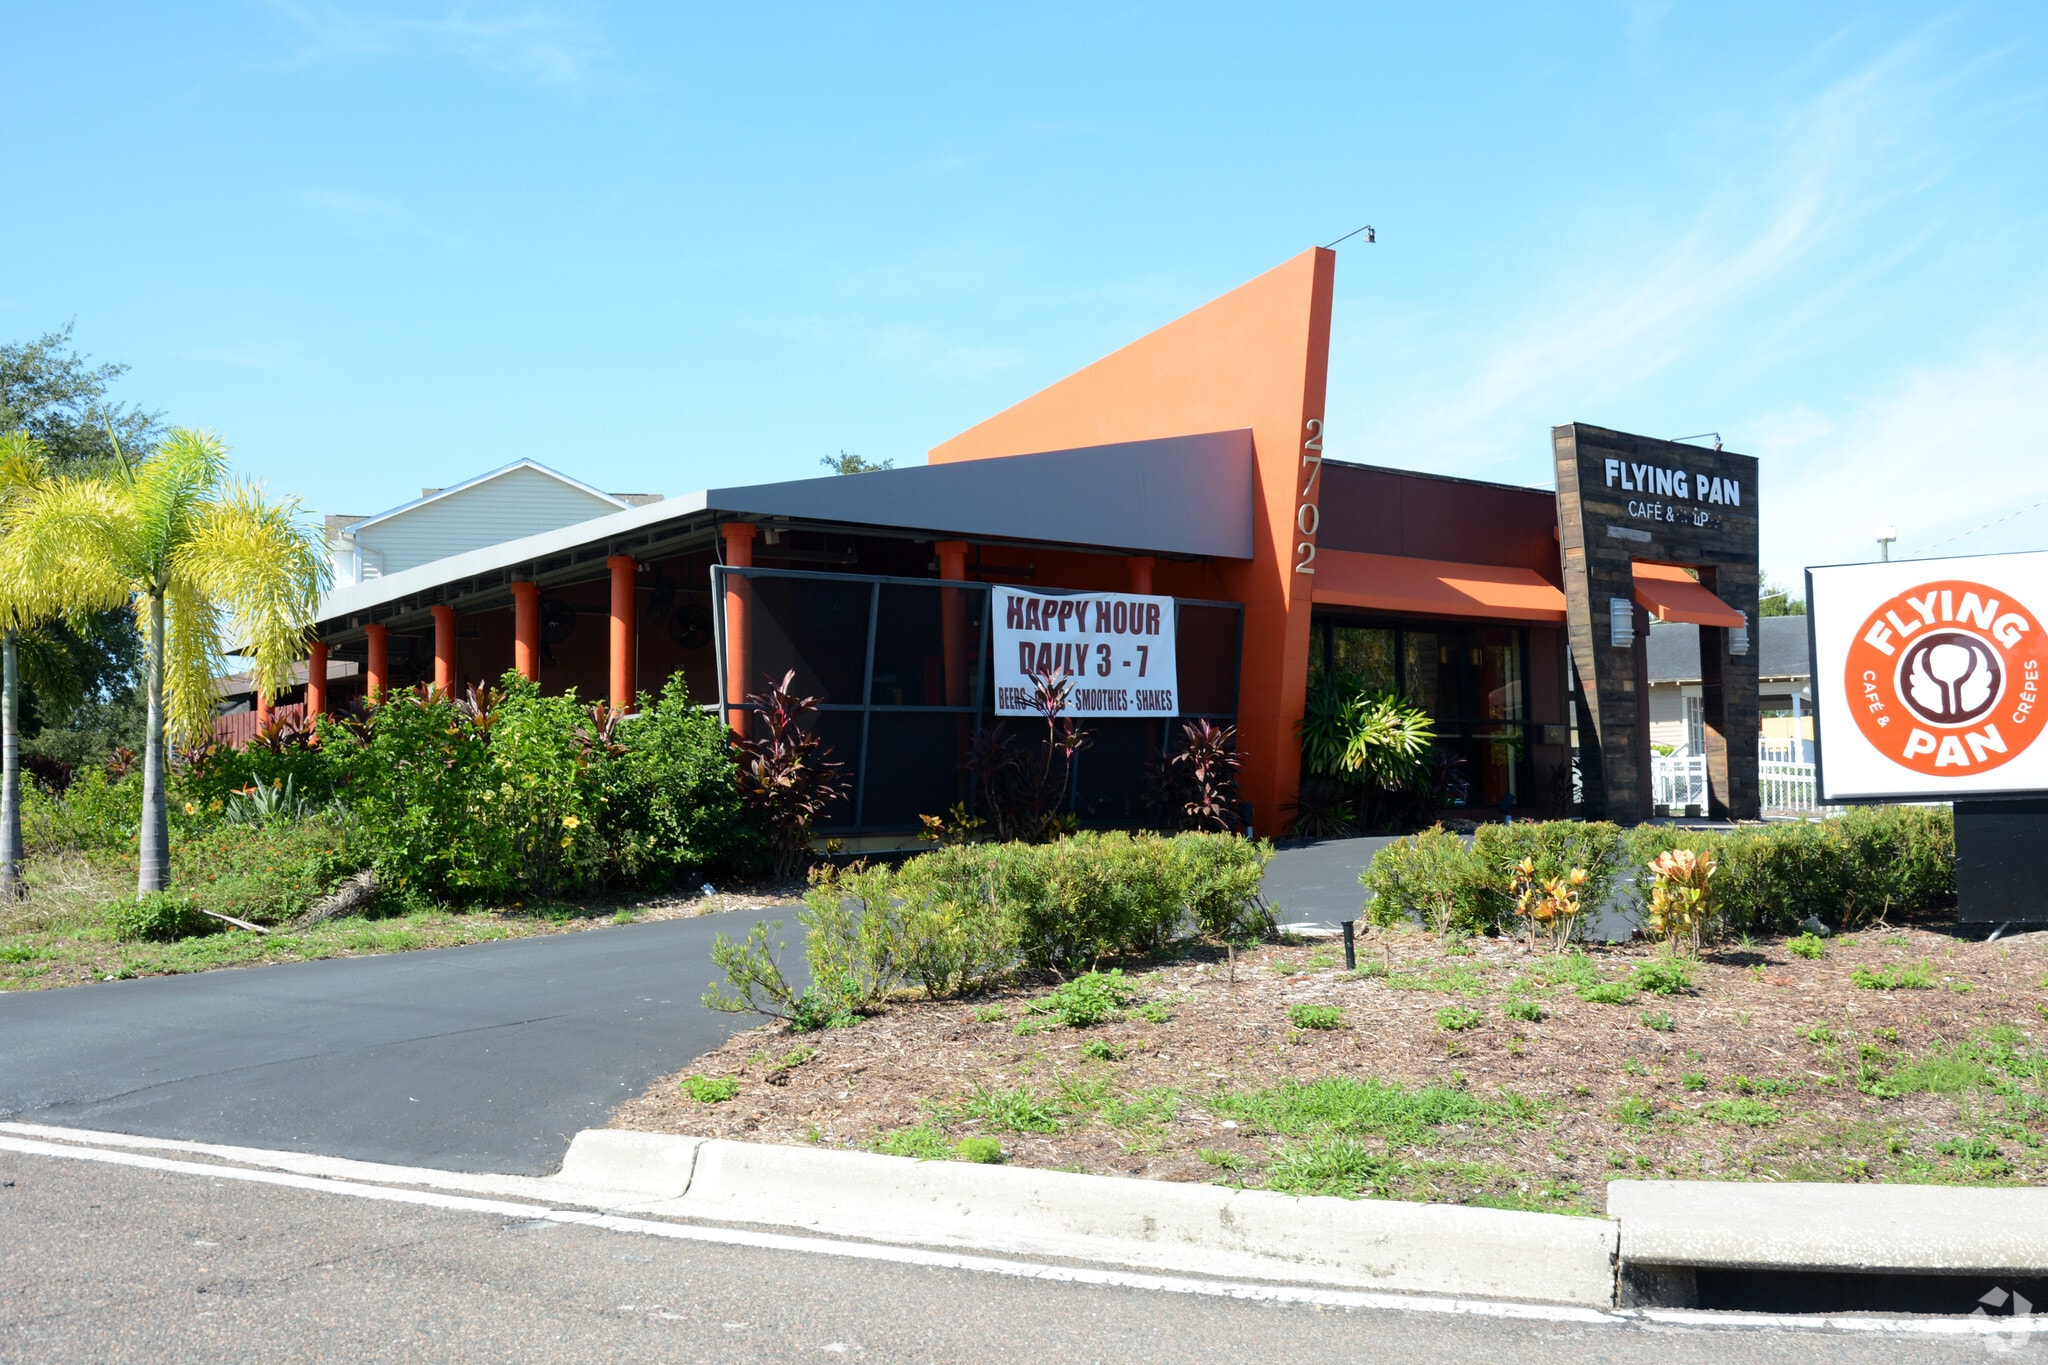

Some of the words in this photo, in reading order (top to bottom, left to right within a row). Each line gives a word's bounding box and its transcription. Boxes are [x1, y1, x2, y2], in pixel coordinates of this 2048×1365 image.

[1296, 418, 1324, 574] 2702
[1605, 458, 1689, 499] FLYING
[1696, 474, 1740, 507] PAN
[1628, 500, 1662, 521] CAFÉ
[1666, 506, 1675, 522] &
[1006, 595, 1090, 633] HAPPY
[1095, 601, 1161, 636] HOUR
[1863, 590, 2030, 657] FLYING
[1018, 641, 1090, 677] DAILY
[1096, 643, 1112, 677] 3
[1136, 645, 1149, 677] 7
[998, 687, 1027, 711] BEERS
[1075, 689, 1128, 712] SMOOTHIES
[1135, 689, 1173, 712] SHAKES
[1863, 670, 1885, 714] CAFÉ
[1877, 715, 1890, 728] &
[2012, 659, 2039, 724] CRÊPES
[1902, 723, 2008, 767] PAN
